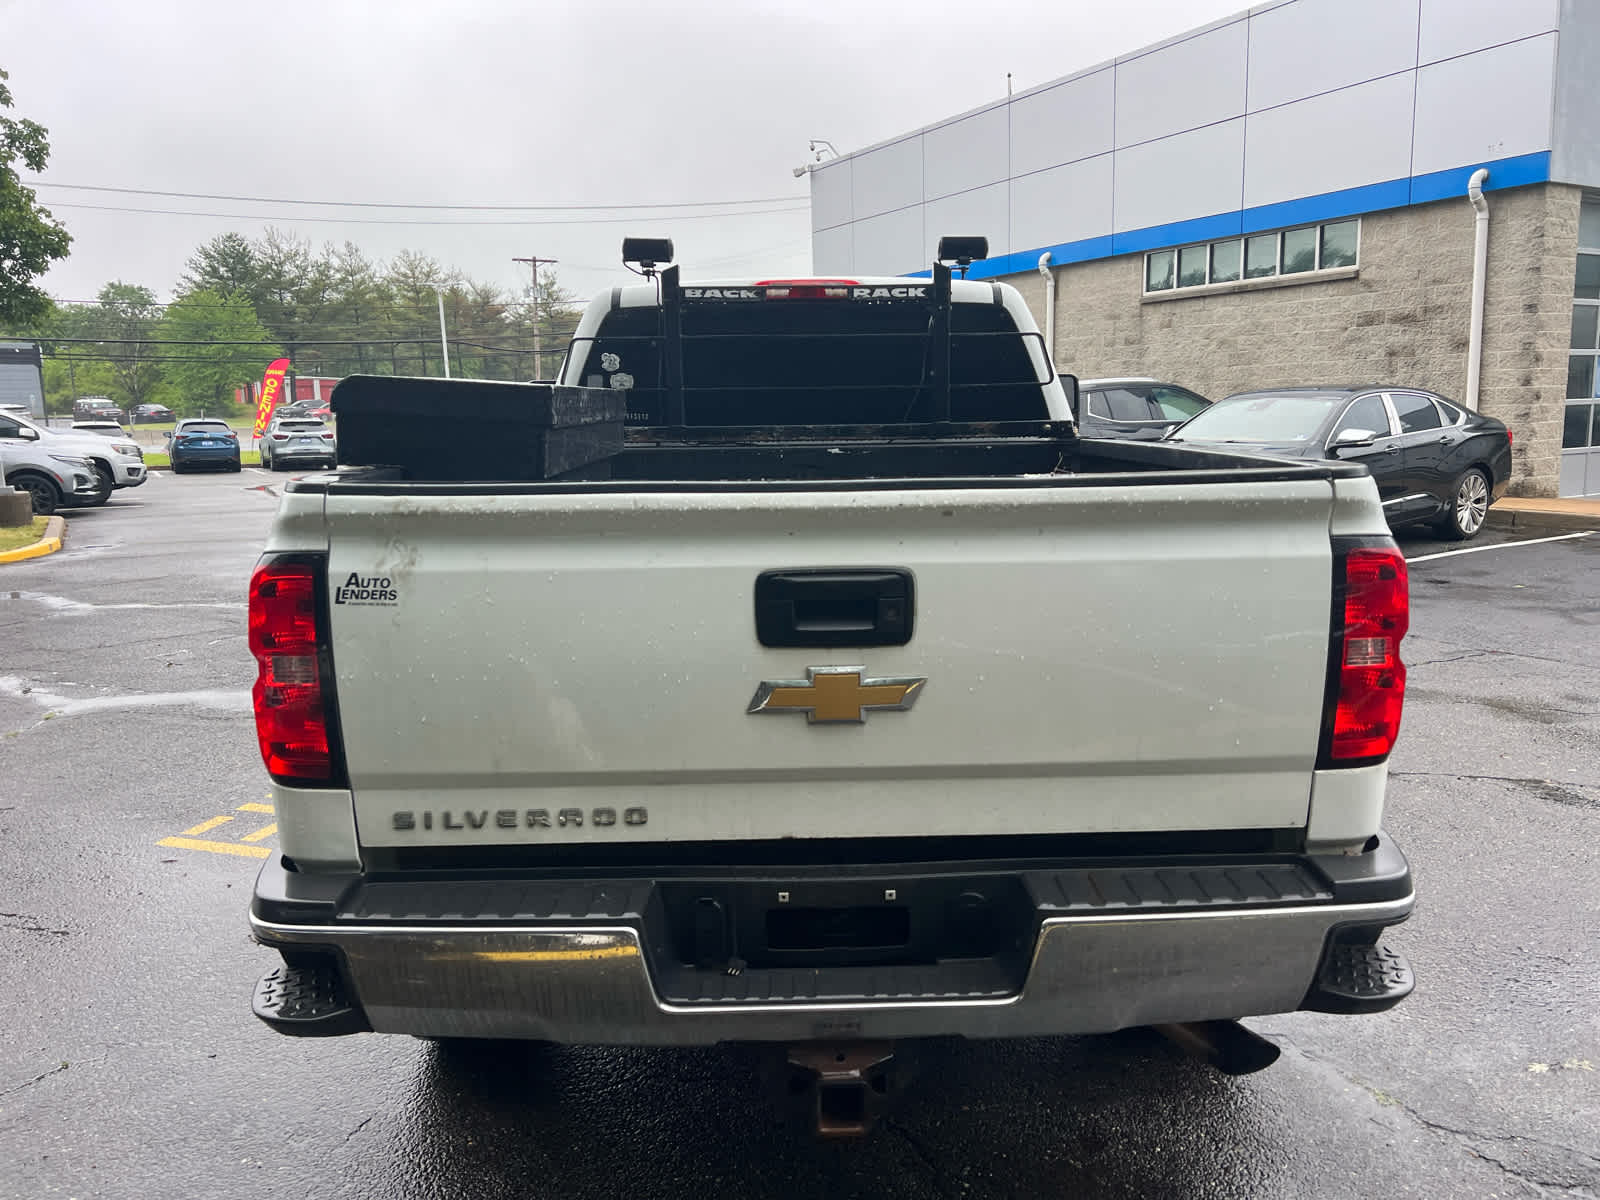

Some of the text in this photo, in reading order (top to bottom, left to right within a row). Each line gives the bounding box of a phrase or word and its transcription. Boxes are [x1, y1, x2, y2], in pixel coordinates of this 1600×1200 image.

[684, 287, 926, 299] BACK RACK
[345, 572, 392, 589] AUTO
[335, 586, 398, 604] LENDERS
[392, 807, 648, 830] SILVERADO
